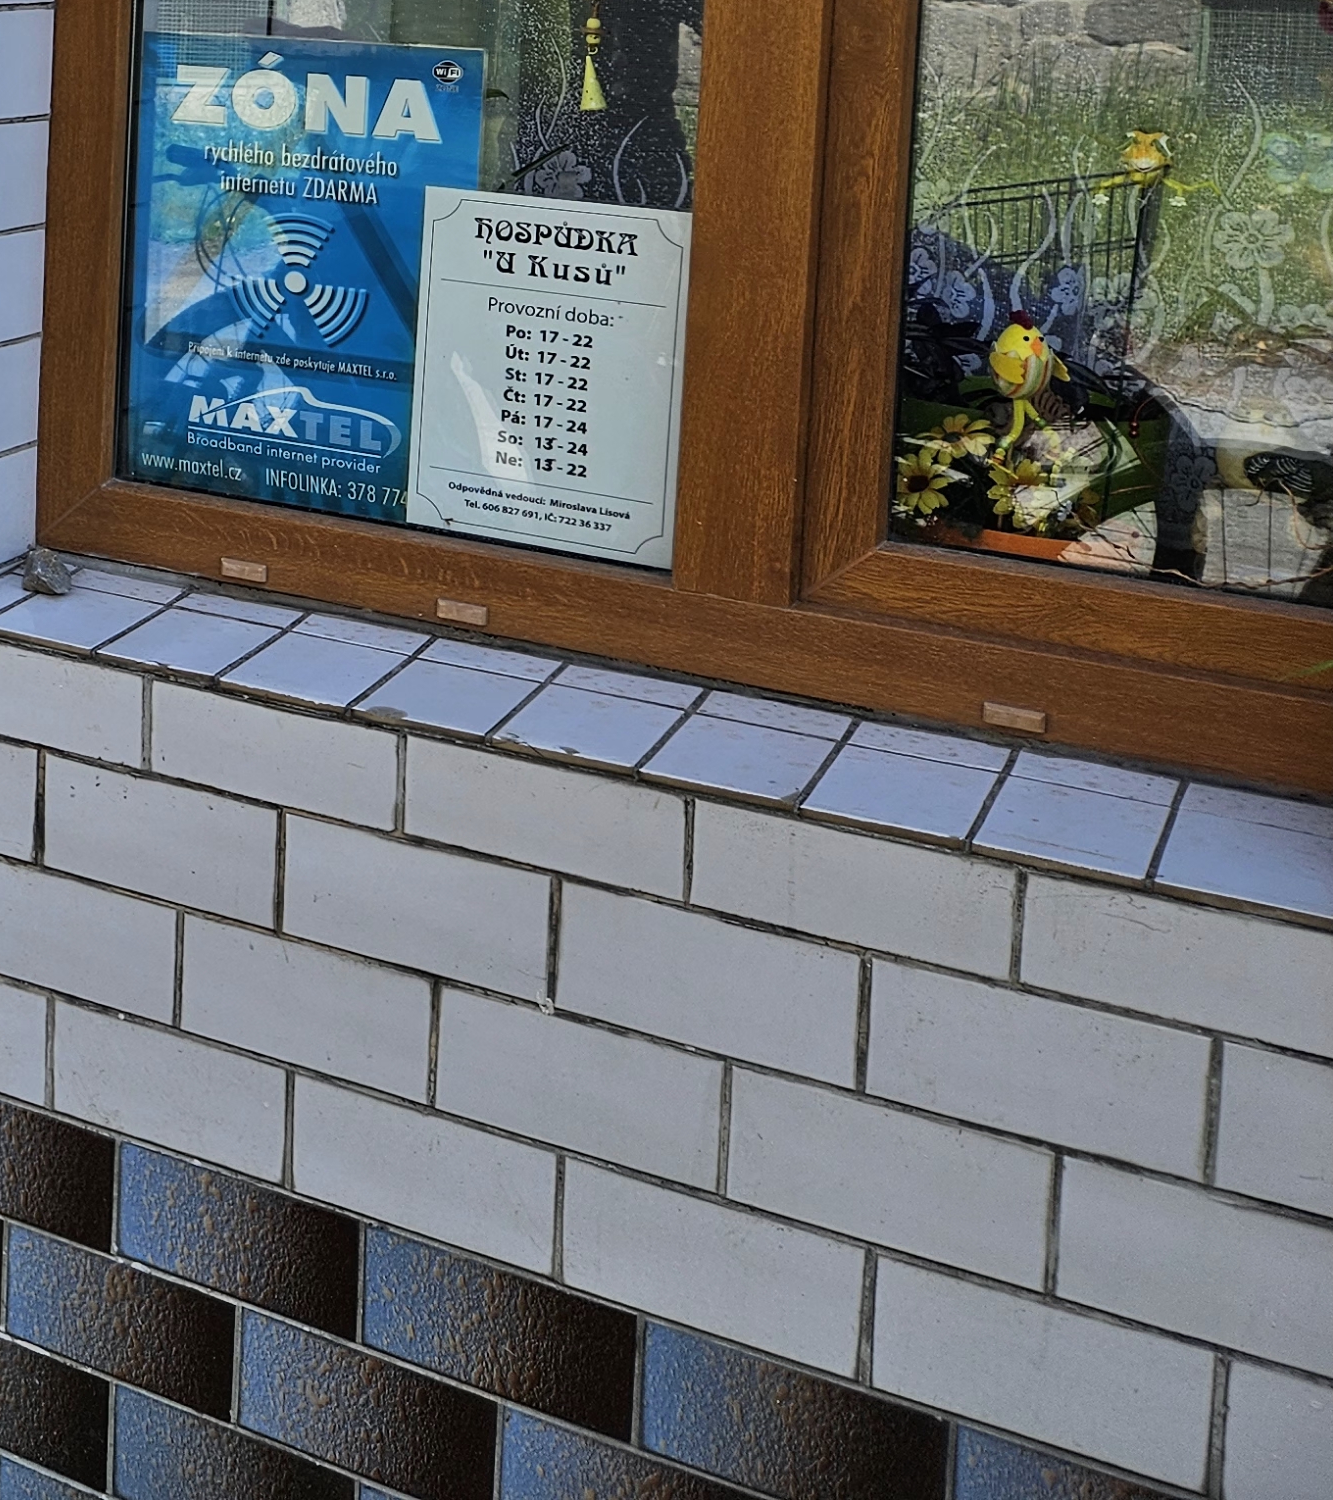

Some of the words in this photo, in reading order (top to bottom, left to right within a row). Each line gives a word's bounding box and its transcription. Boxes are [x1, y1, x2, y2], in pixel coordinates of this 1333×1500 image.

[170, 51, 443, 143] ZÓNA
[204, 140, 274, 166] rychlého
[282, 144, 398, 176] bezdrátového
[220, 171, 295, 196] internetu
[303, 177, 378, 204] ZDARMA
[474, 217, 638, 256] HOSPŮDKA
[483, 250, 516, 274] "U
[528, 254, 626, 286] Kusů"
[488, 296, 561, 320] Provozní
[565, 307, 614, 327] doba:
[506, 325, 532, 340] Po:
[226, 346, 233, 357] k
[235, 348, 273, 363] internetu
[275, 353, 291, 365] zde
[293, 354, 335, 372] poskytuje
[337, 362, 373, 377] MAXTEL
[375, 369, 398, 381] s.r.o.
[505, 344, 530, 361] Út:
[505, 367, 527, 382] St:
[503, 386, 526, 403] Čt:
[188, 395, 382, 451] MAXTEL
[501, 409, 526, 425] Pá:
[187, 432, 262, 455] Broadband
[266, 445, 318, 464] internet
[321, 455, 381, 474] provider
[497, 430, 523, 446] So:
[496, 451, 522, 467] Ne:
[141, 452, 242, 481] www.maxtel.cz
[265, 468, 342, 498] INFOLINKA:
[347, 482, 376, 503] 378
[448, 481, 504, 498] Odpovědná
[505, 489, 546, 506] vedoucí:
[549, 499, 598, 515] Miroslava
[599, 507, 631, 520] Lisová
[464, 499, 481, 510] Tel.
[482, 502, 501, 513] 606
[501, 506, 520, 516] 827
[521, 509, 543, 522] 691,
[578, 519, 592, 529] 36
[593, 522, 612, 532] 337
